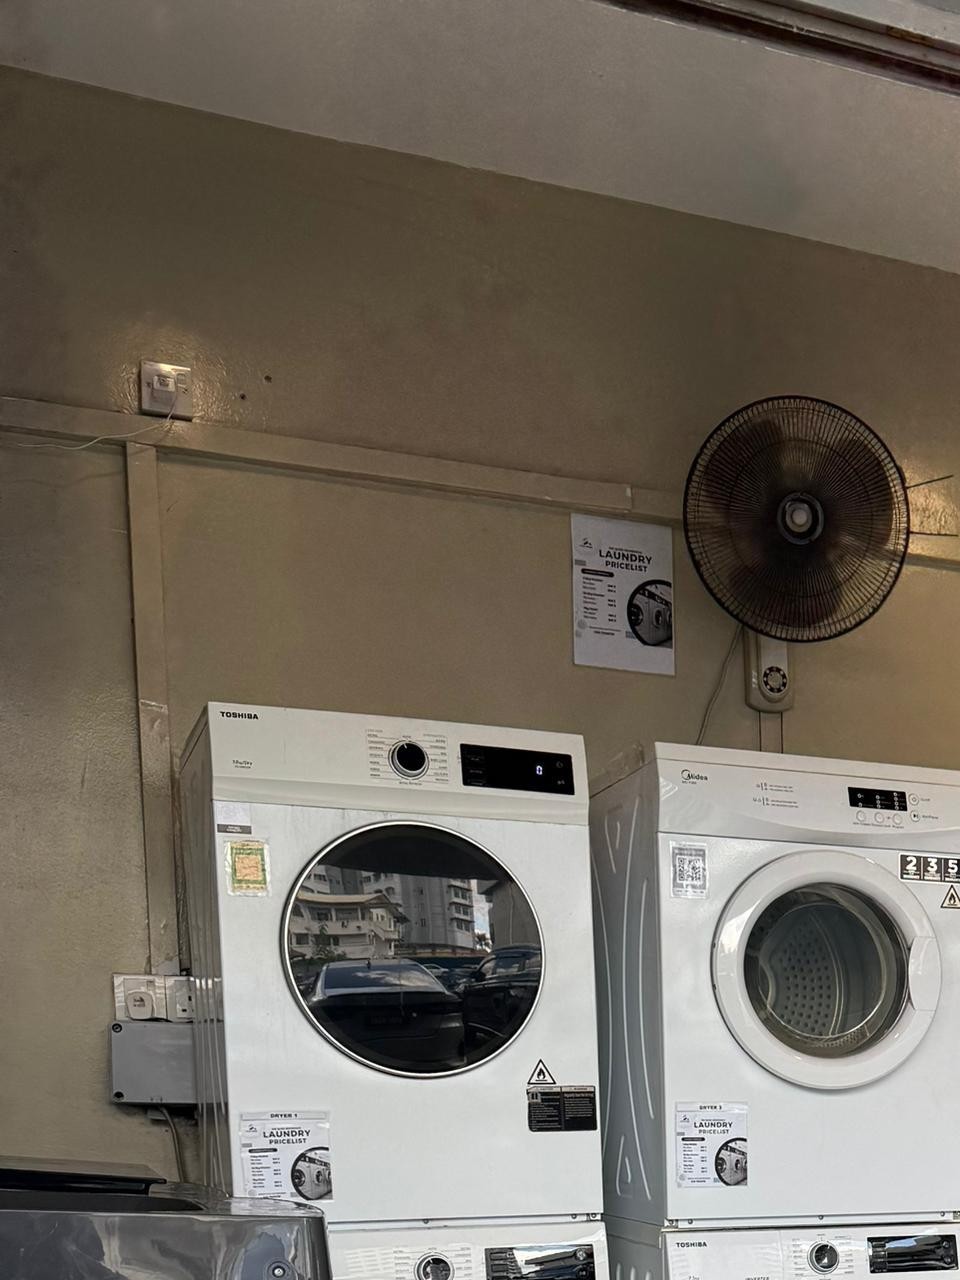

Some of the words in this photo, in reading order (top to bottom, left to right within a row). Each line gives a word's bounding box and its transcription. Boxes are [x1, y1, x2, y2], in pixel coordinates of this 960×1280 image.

[599, 549, 652, 565] LAUNDRY
[605, 560, 648, 573] PRICELIST
[220, 711, 259, 720] TOSHIBA
[681, 769, 708, 780] Midea
[906, 856, 917, 870] 2
[927, 858, 938, 871] 3
[948, 860, 958, 873] 5
[263, 1130, 311, 1139] LAUNDRY
